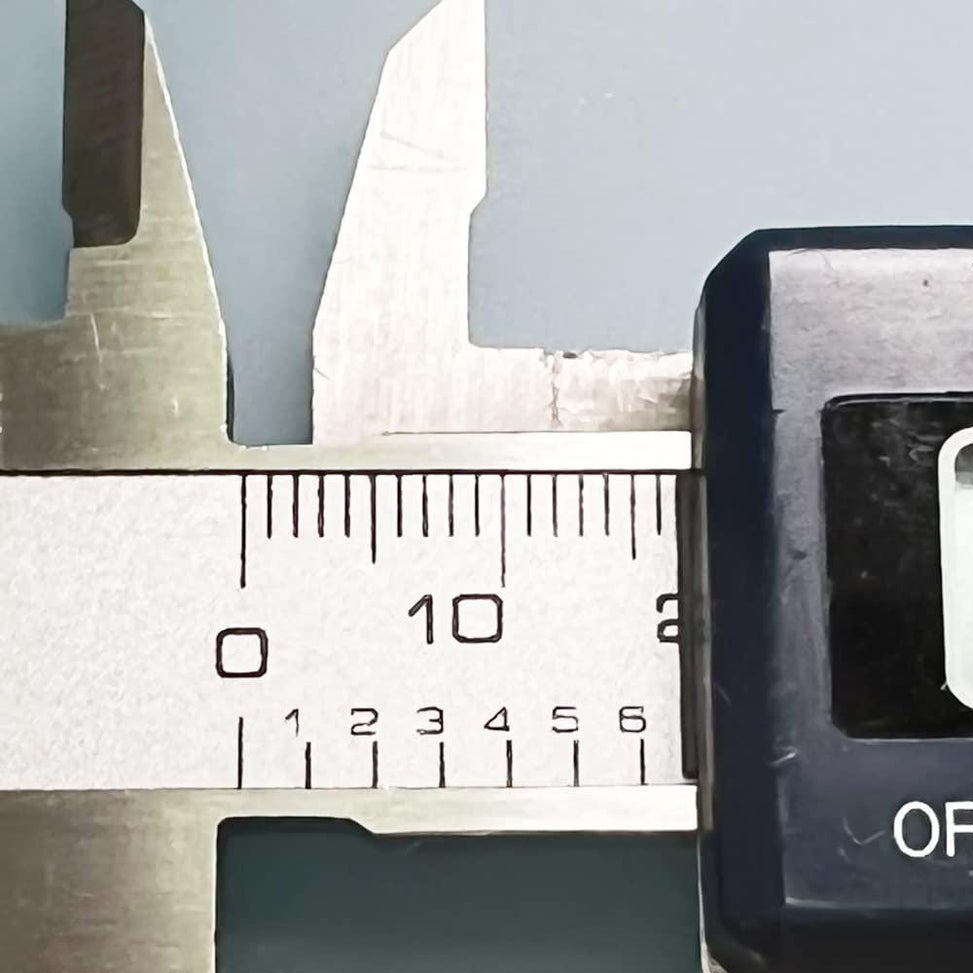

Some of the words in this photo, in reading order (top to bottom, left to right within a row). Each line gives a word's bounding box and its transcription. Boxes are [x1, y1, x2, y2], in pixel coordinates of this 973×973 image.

[408, 594, 503, 644] 10
[216, 627, 268, 678] 0
[285, 707, 300, 737] 1
[350, 707, 378, 735] 2
[416, 706, 444, 735] 3
[483, 706, 510, 732] 4
[552, 706, 579, 732] 5
[619, 706, 647, 732] 6
